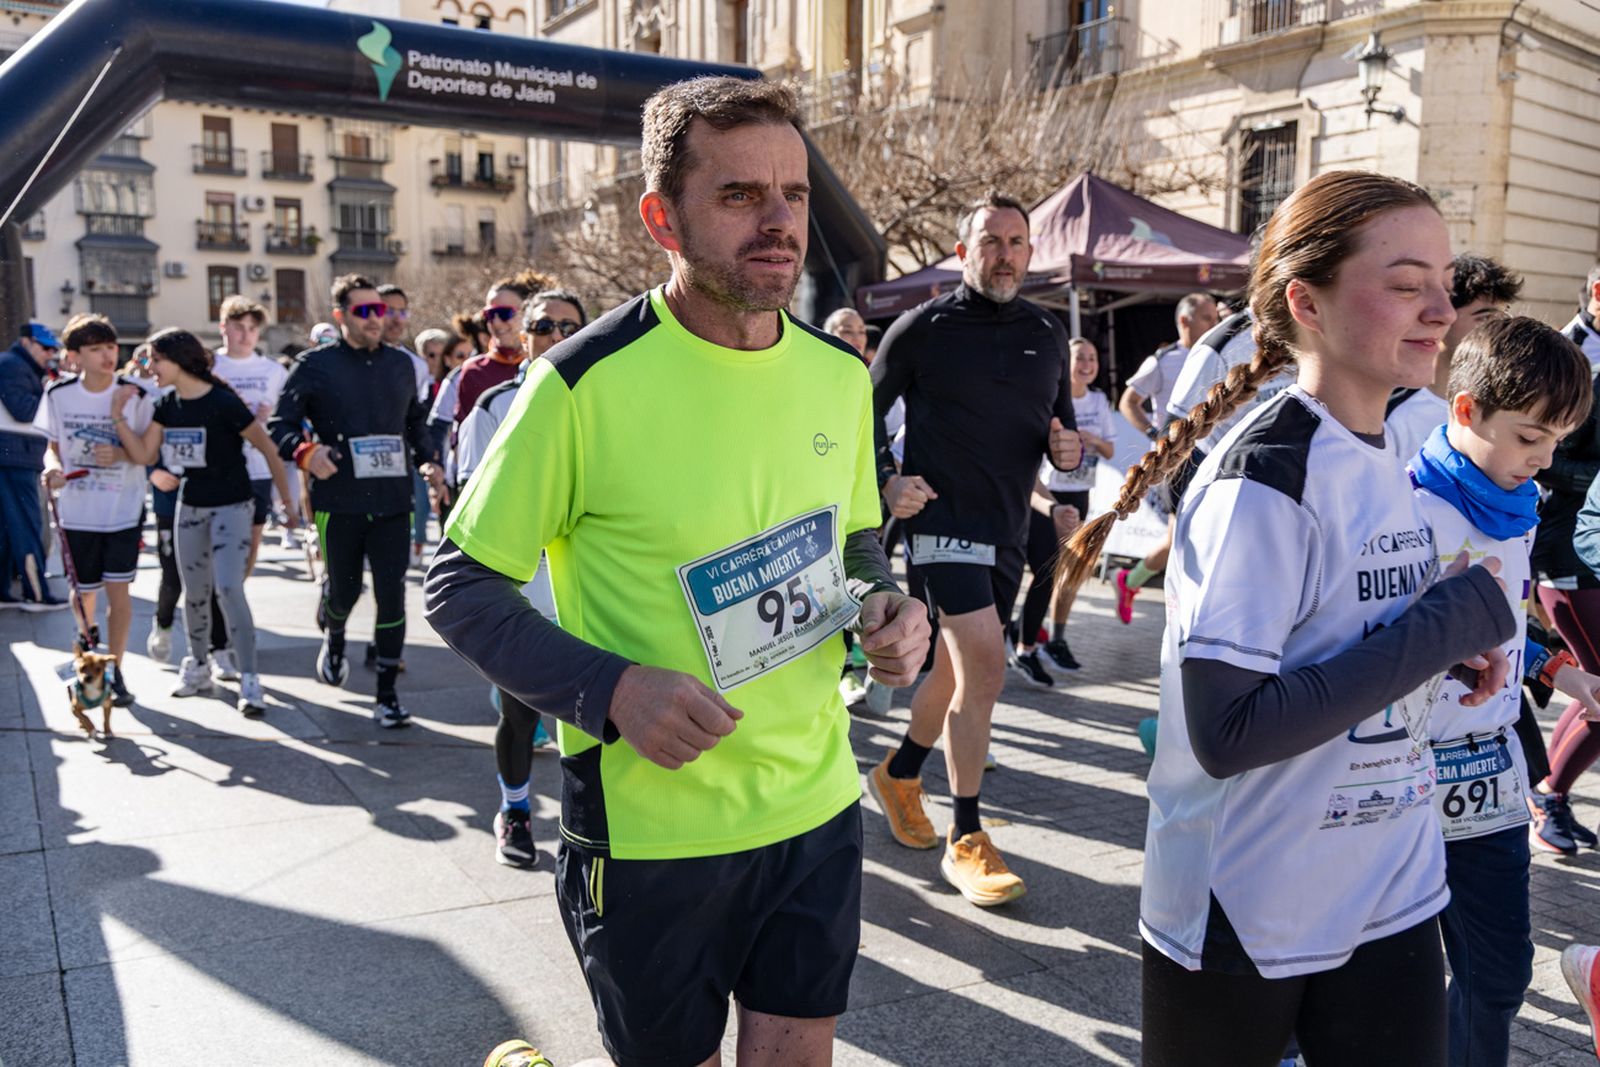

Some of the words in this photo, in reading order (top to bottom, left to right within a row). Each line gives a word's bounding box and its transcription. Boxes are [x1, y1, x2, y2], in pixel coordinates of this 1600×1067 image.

[407, 50, 492, 77] Patronato
[495, 61, 573, 87] Municipal
[576, 72, 598, 90] de
[407, 71, 486, 96] Deportes
[490, 81, 513, 99] de
[515, 85, 556, 104] Jaén
[706, 565, 720, 580] VI
[720, 543, 771, 575] CARRERA
[770, 520, 817, 555] CAMINATA
[711, 571, 759, 606] BUENA
[758, 547, 803, 585] MUERTE
[1357, 563, 1417, 602] BUENA
[757, 576, 812, 637] 95
[748, 641, 777, 658] MANUEL
[1436, 765, 1459, 780] ENA
[1460, 757, 1498, 778] MUERTE
[1442, 776, 1498, 819] 691
